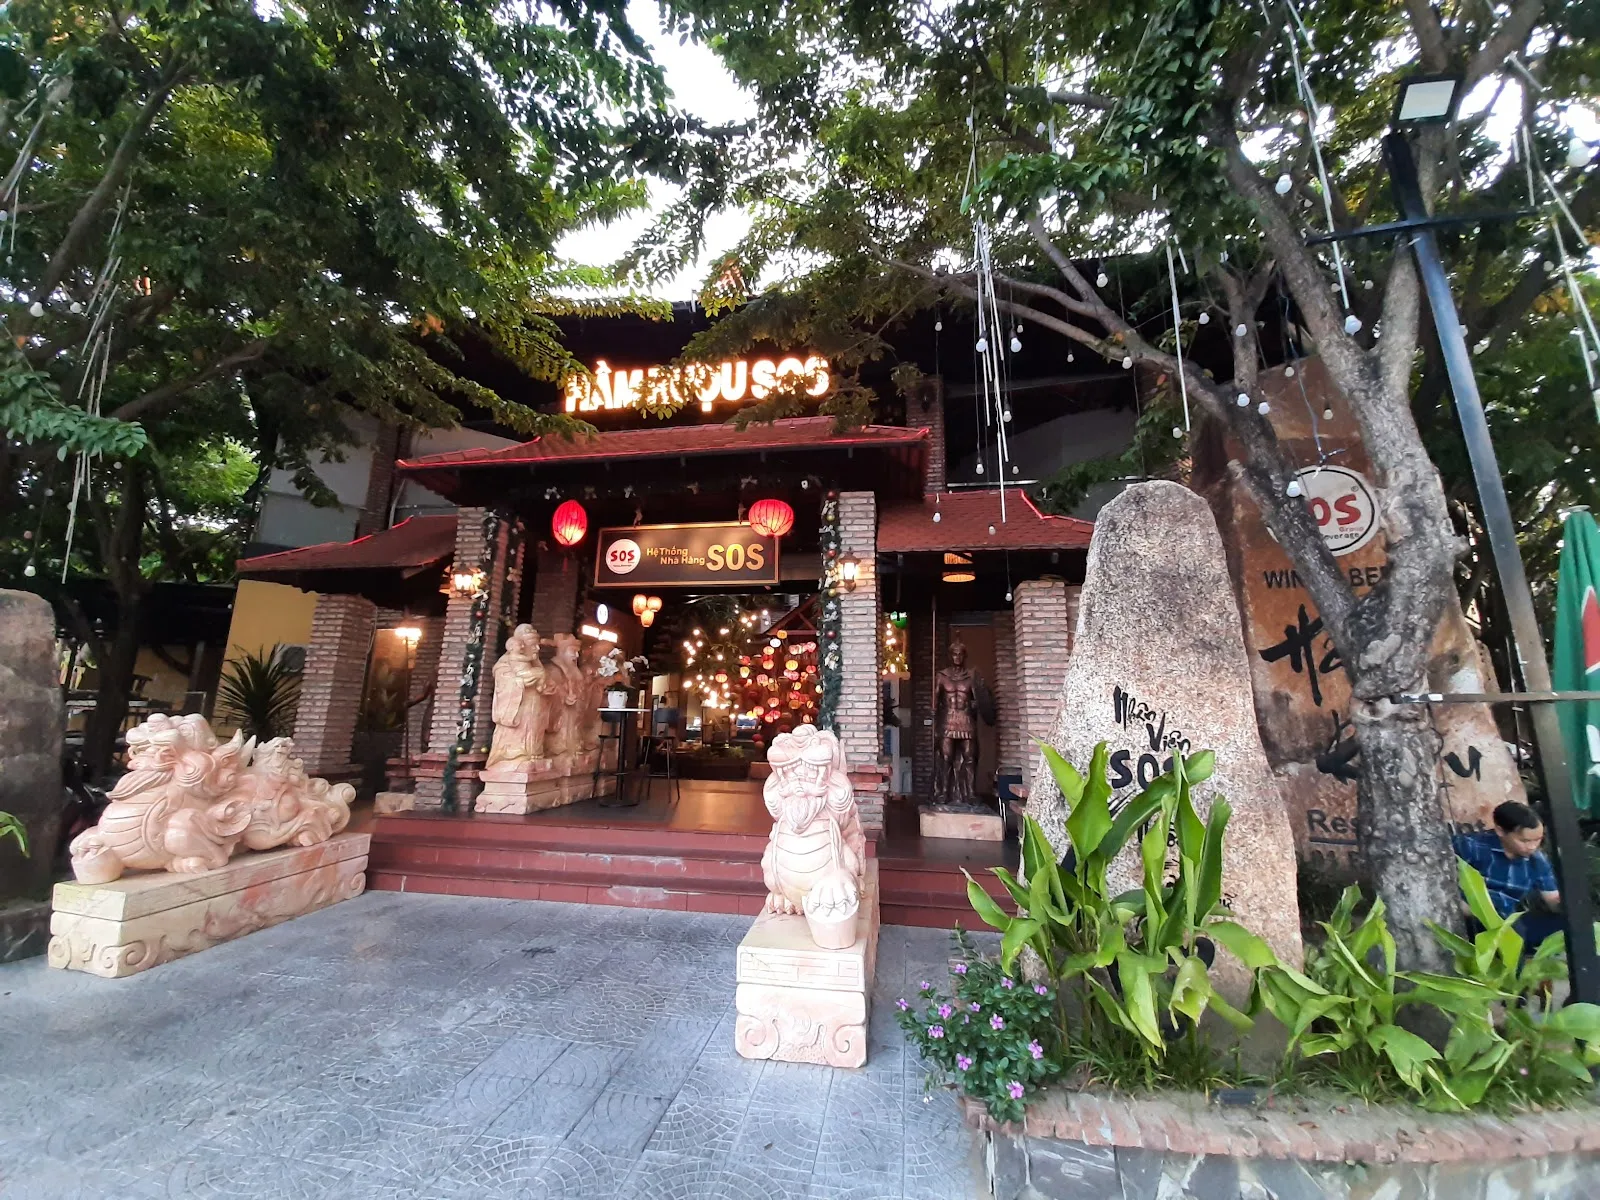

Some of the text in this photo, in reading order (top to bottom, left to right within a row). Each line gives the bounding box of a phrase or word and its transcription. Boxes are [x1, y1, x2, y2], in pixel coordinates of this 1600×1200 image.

[751, 356, 830, 400] SOS
[1308, 493, 1361, 527] OS
[610, 550, 635, 562] SOS
[681, 556, 706, 566] Hàng
[706, 543, 765, 572] SOS
